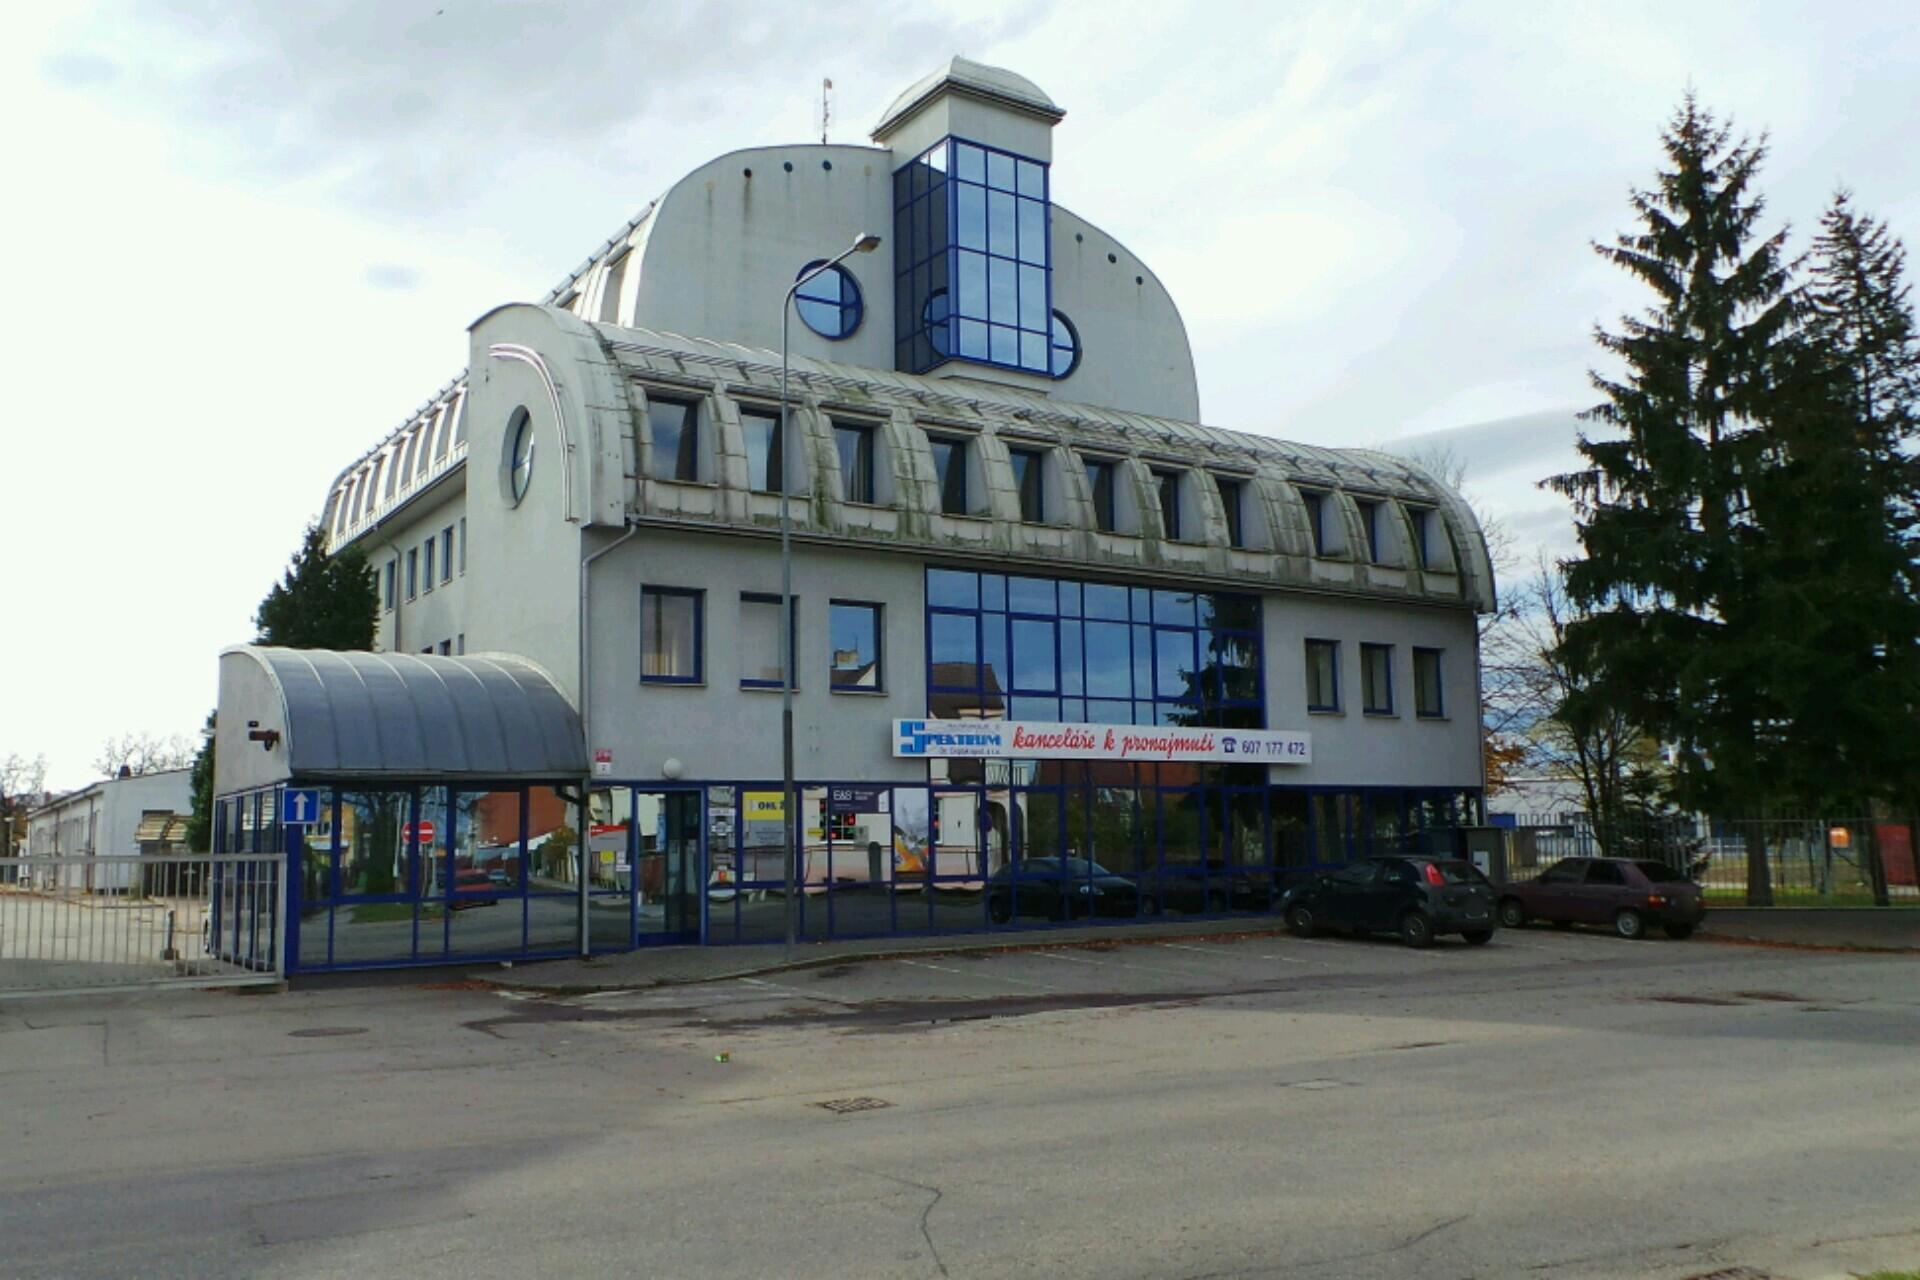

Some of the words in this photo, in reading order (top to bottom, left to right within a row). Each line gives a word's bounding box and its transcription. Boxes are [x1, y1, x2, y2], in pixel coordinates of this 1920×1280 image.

[1013, 726, 1096, 749] kanceláře
[1103, 728, 1115, 751] k
[1242, 740, 1261, 754] 607
[1266, 742, 1284, 755] 177
[1288, 742, 1305, 756] 472
